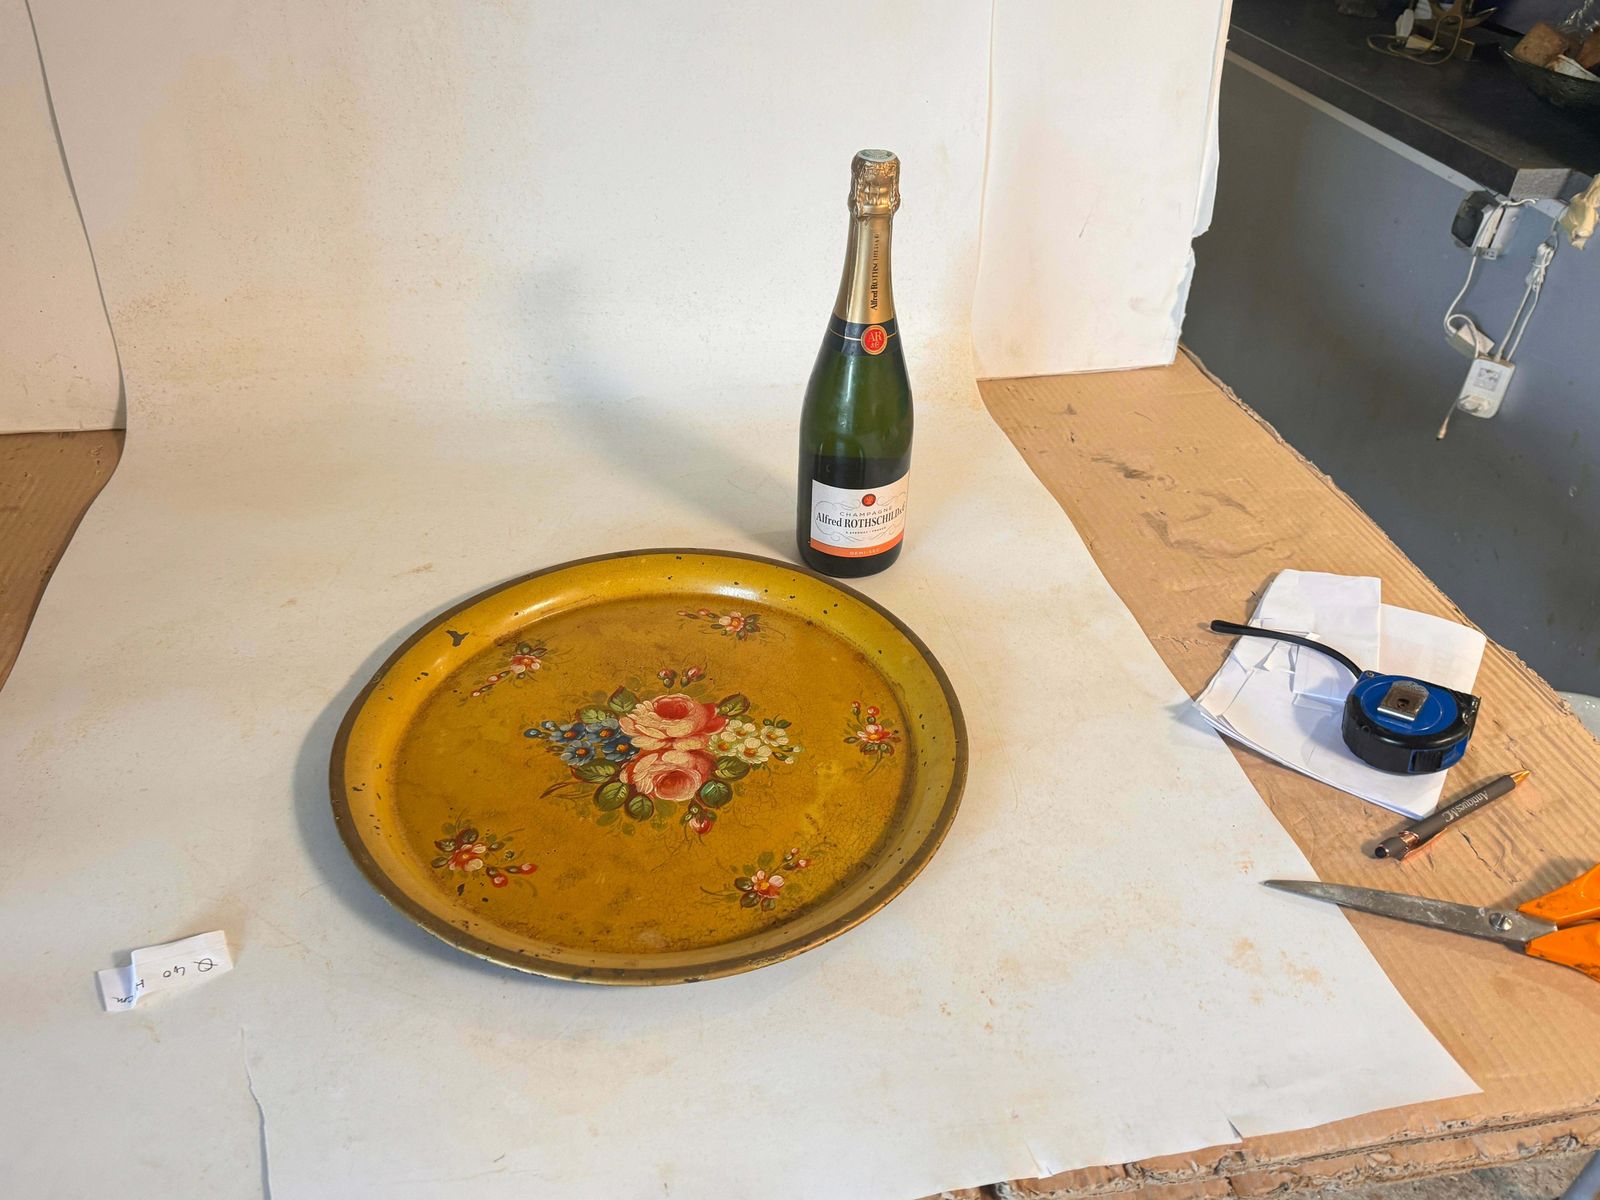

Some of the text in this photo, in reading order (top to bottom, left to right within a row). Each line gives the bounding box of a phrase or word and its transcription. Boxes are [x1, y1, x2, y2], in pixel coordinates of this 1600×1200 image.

[870, 290, 878, 310] Alfred
[867, 331, 882, 342] AR
[816, 512, 842, 527] Alfred
[844, 507, 900, 528] ROTHSCHILD
[839, 506, 892, 517] CHAMPAGNE
[1442, 791, 1488, 822] AntiquesMC
[163, 965, 185, 978] 40
[112, 995, 134, 1003] cm
